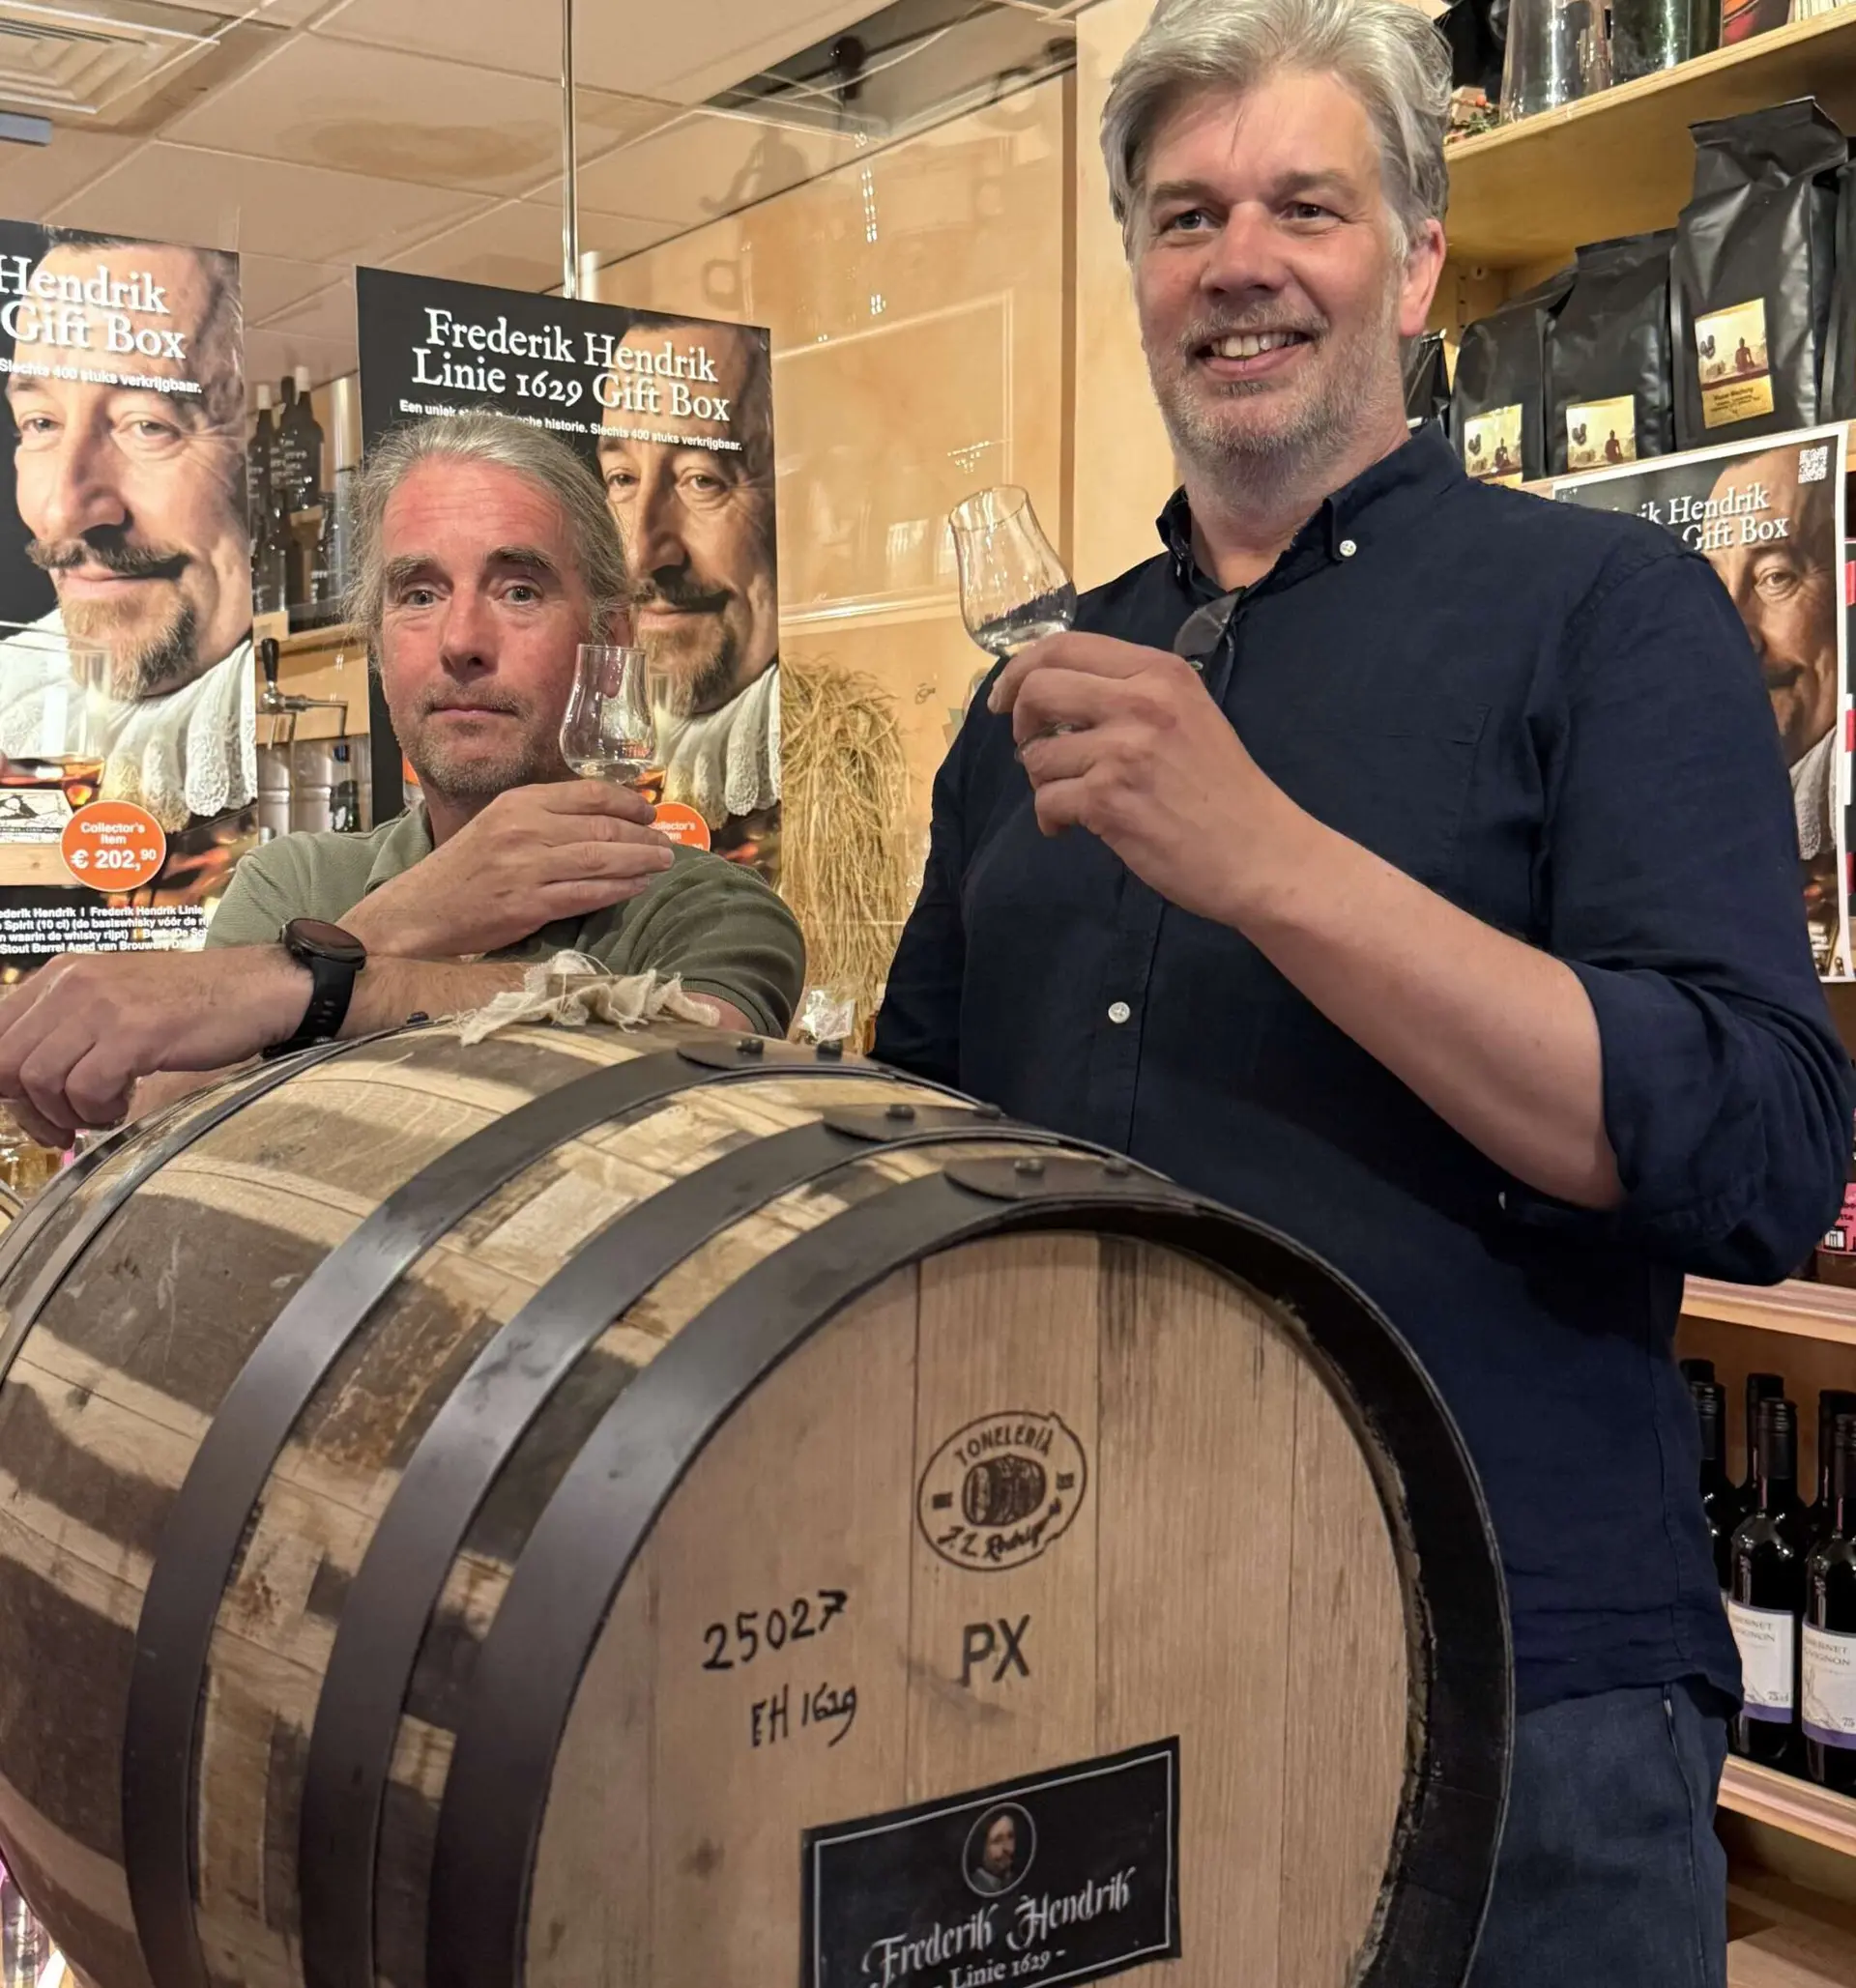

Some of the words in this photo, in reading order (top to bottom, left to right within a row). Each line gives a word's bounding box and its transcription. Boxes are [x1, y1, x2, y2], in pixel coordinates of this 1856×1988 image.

[0, 254, 171, 315] Hendrik
[0, 301, 92, 349] Gift
[103, 310, 187, 360] Box
[423, 307, 576, 363] Frederik
[583, 331, 719, 384] Hendrik
[0, 358, 50, 378] Slechts
[53, 366, 78, 380] 400
[81, 369, 118, 385] stuks
[119, 373, 202, 394] verkrijgbaar.
[411, 348, 507, 394] Linie
[515, 371, 583, 407] 1629
[592, 373, 660, 415] Gift
[670, 383, 731, 422] Box
[399, 399, 423, 414] Een
[544, 418, 589, 434] historie.
[591, 422, 629, 440] Slechts
[631, 429, 651, 442] 400
[652, 431, 680, 445] stuks
[682, 436, 743, 452] verkrijgbaar.
[1668, 482, 1771, 526] Hendrik
[1682, 518, 1734, 552] Gift
[1739, 517, 1789, 545] Box
[80, 821, 146, 834] Collector's
[101, 834, 128, 845] Item
[70, 850, 90, 870] €
[4, 920, 35, 932] Spirit
[72, 918, 90, 931] (de
[184, 916, 197, 926] de
[33, 907, 76, 918] Hendrik
[90, 907, 134, 917] Frederik
[135, 905, 176, 916] Hendrik
[178, 905, 204, 915] Linie
[0, 943, 30, 955] Stout
[32, 942, 66, 953] Barrel
[98, 941, 117, 952] van
[47, 931, 62, 941] de
[64, 930, 102, 942] whisky
[702, 1589, 848, 1670] 25027
[960, 1613, 1031, 1687] PX
[860, 1903, 1000, 1988] Frederik
[1006, 1865, 1137, 1951] Hendrik
[949, 1958, 1007, 1988] Linie
[1011, 1950, 1052, 1978] 1629
